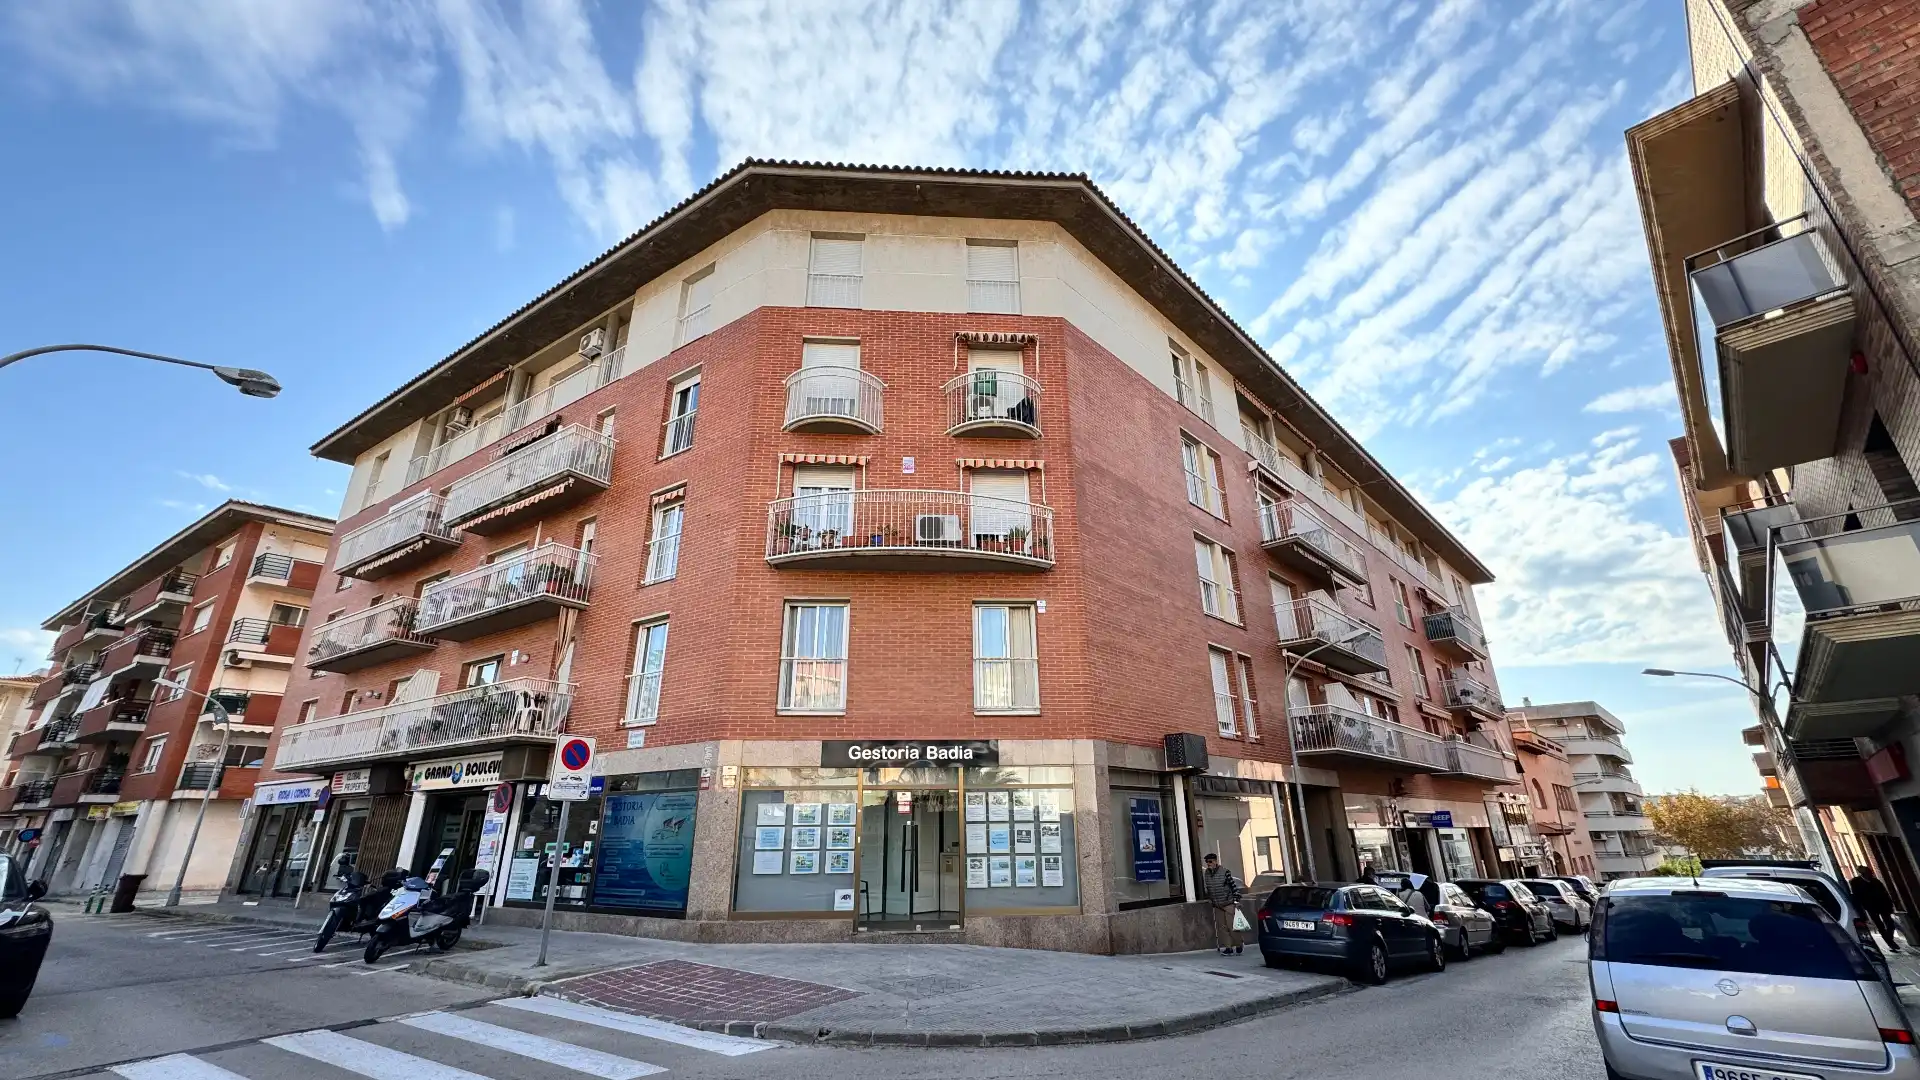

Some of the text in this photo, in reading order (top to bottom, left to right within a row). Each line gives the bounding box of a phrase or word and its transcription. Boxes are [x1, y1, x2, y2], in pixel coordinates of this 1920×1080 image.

[848, 745, 973, 760] Gestoria Badia
[424, 765, 453, 780] GRAND
